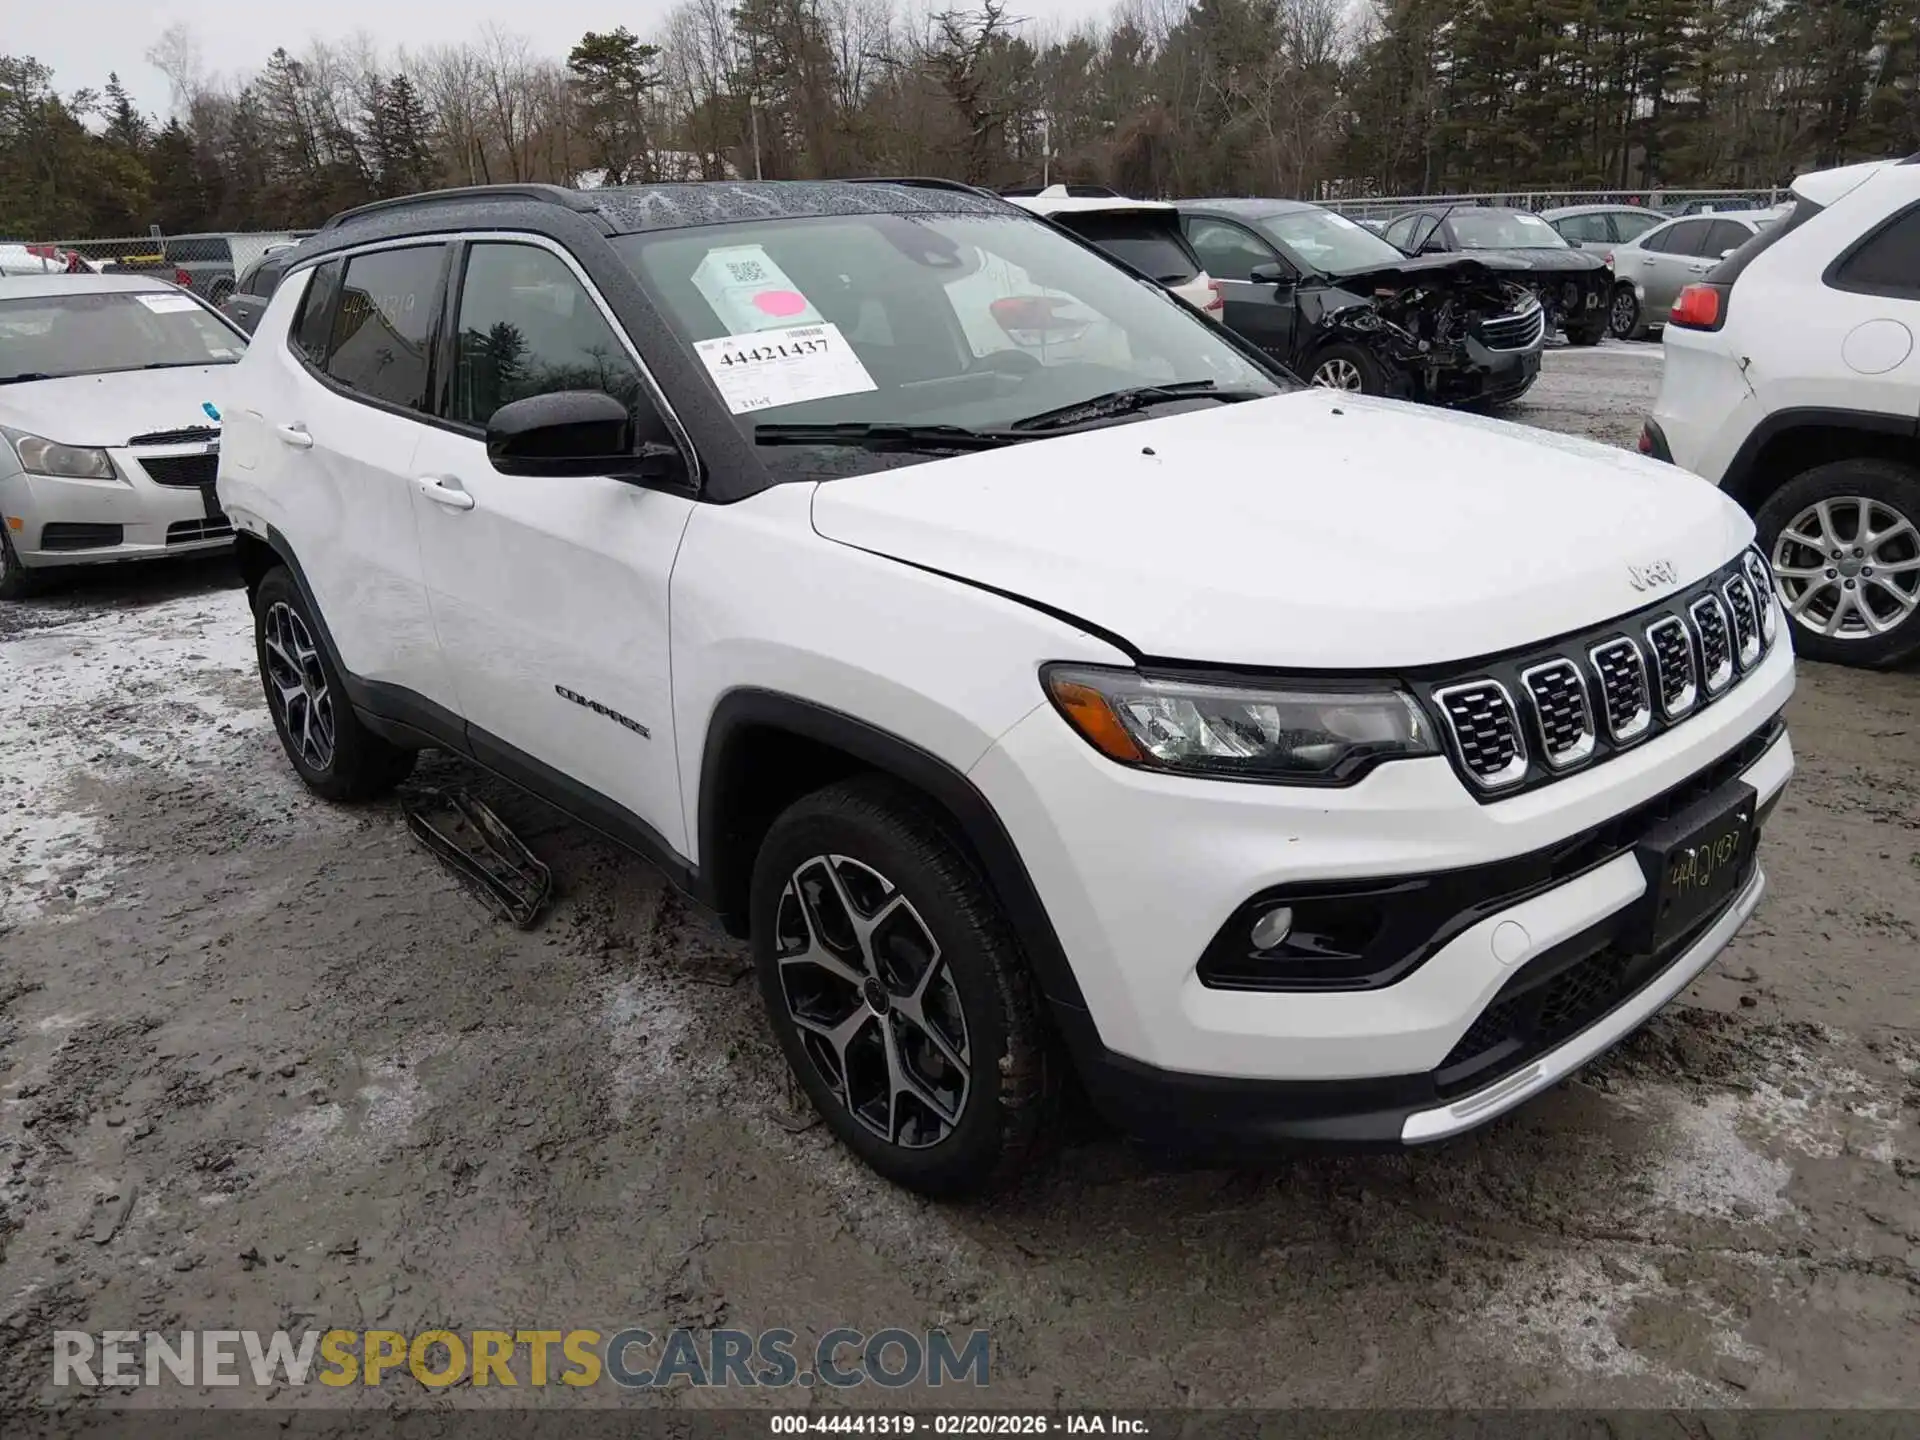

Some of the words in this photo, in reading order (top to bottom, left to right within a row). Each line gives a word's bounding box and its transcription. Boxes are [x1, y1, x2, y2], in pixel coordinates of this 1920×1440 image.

[720, 339, 829, 366] 44421437
[1627, 561, 1677, 592] Jeep
[554, 684, 651, 740] COMPASS
